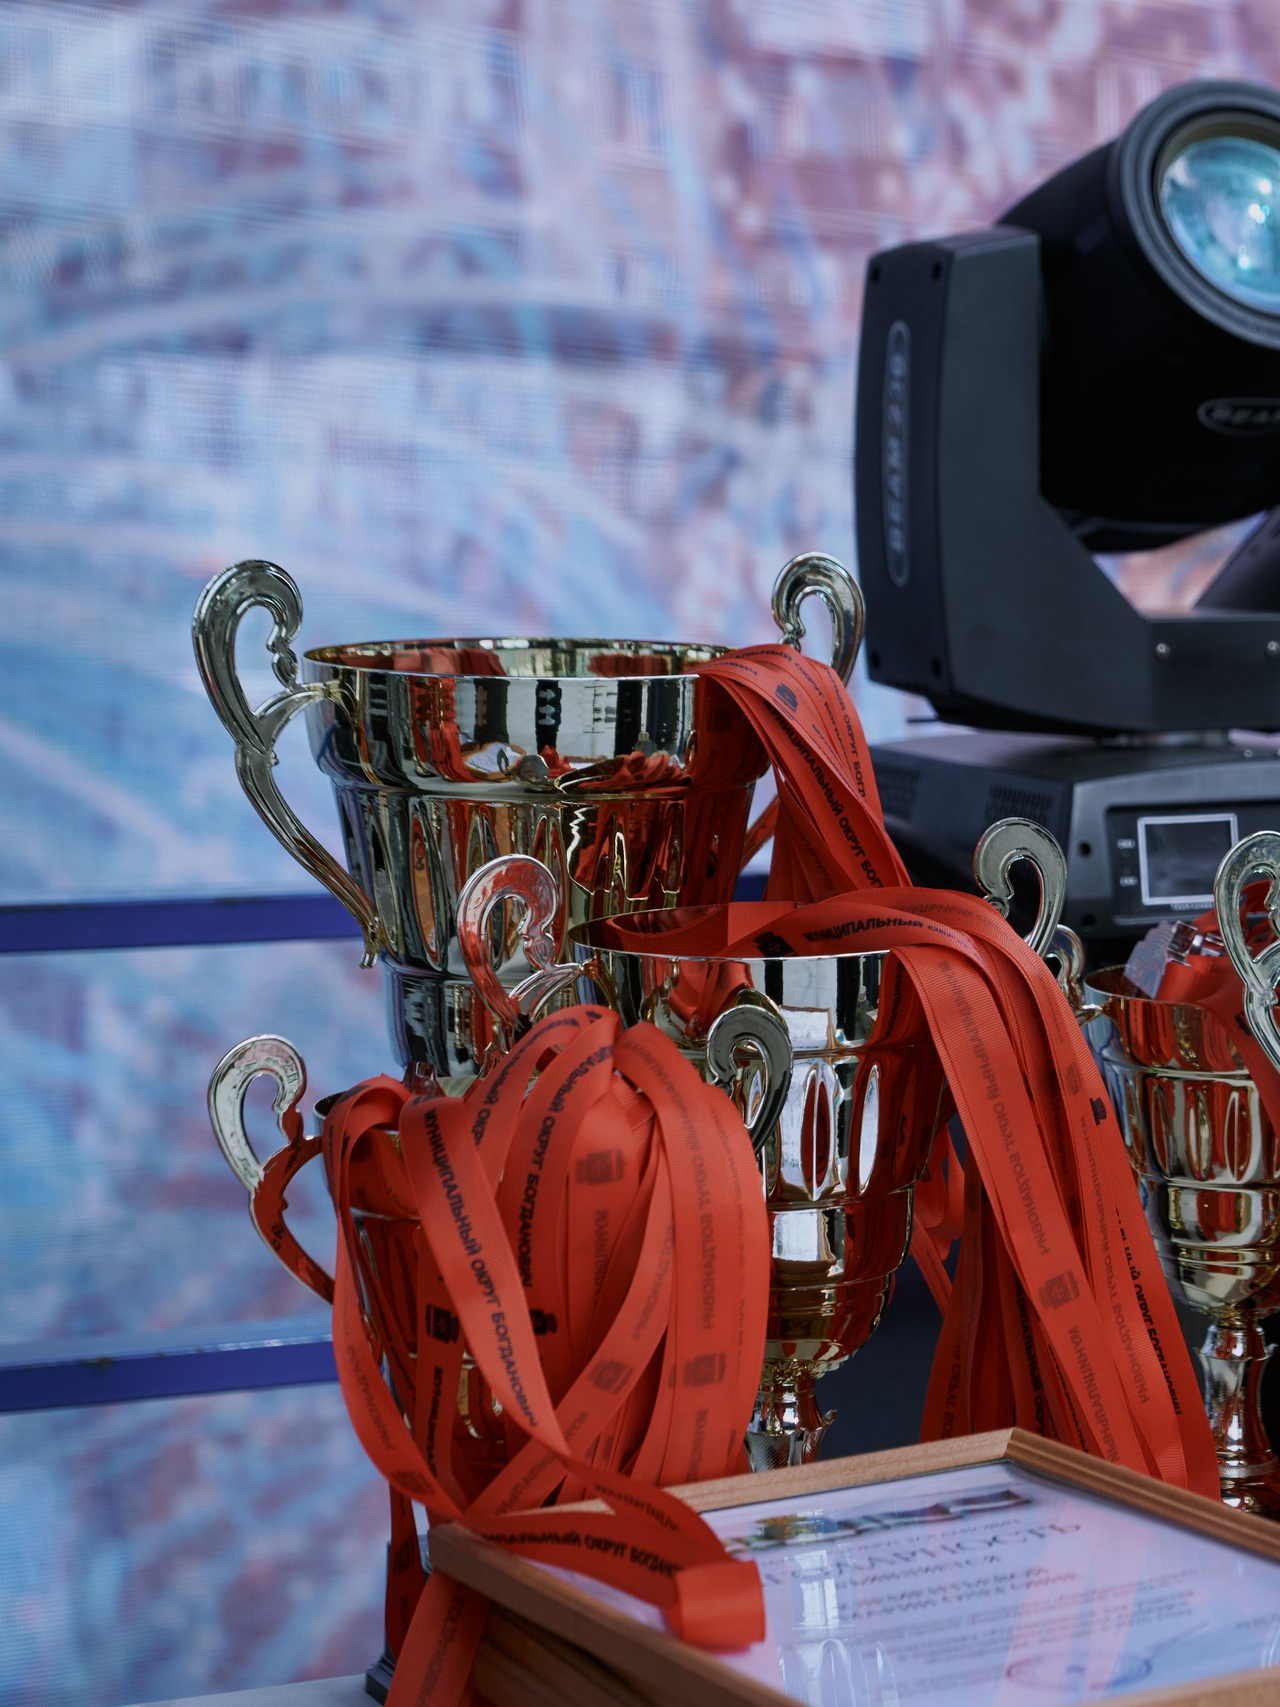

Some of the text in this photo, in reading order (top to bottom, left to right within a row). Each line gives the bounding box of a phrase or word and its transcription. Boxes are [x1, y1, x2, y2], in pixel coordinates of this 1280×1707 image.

[838, 815, 868, 858] ОКРУГ
[471, 1109, 491, 1146] ОКР
[533, 1115, 556, 1171] ОКРУГ
[423, 1109, 538, 1428] МУНИЦИПАЛЬНЫЙ ОКРУГ БОГДАНОВИЧ
